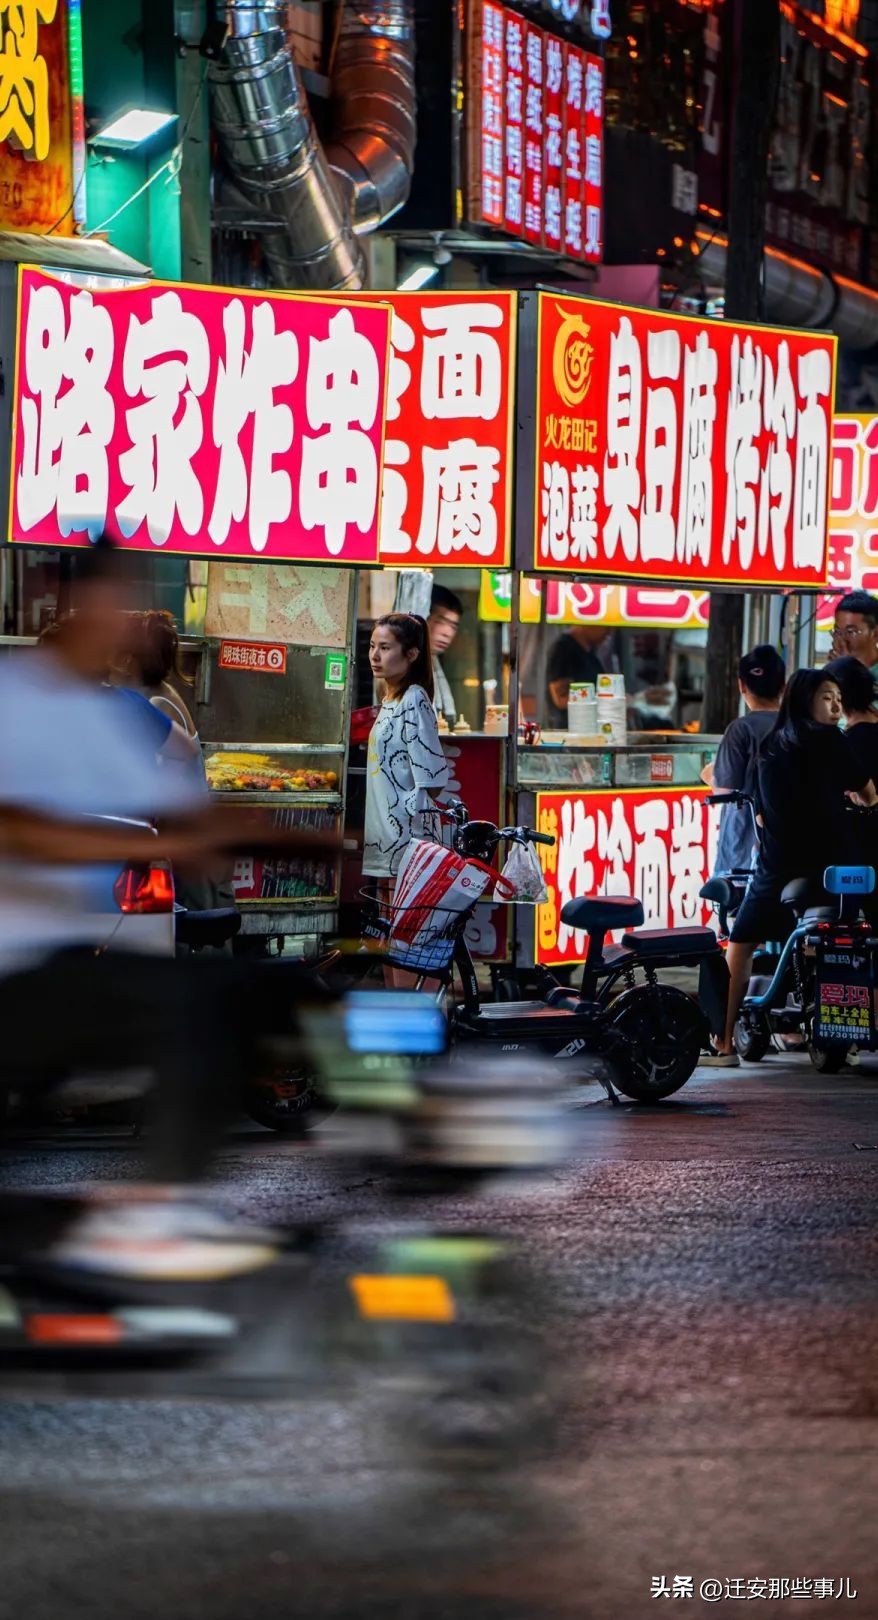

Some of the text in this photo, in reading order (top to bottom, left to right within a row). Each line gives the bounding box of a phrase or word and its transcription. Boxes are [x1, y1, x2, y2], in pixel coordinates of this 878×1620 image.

[17, 284, 380, 555] 路家炸串
[544, 413, 598, 454] 火龙田记
[603, 316, 718, 568] 臭豆腐
[722, 333, 831, 573] 烤冷面
[541, 461, 599, 563] 泡菜
[223, 645, 267, 667] 明珠街夜市
[820, 983, 870, 1008] 爱玛
